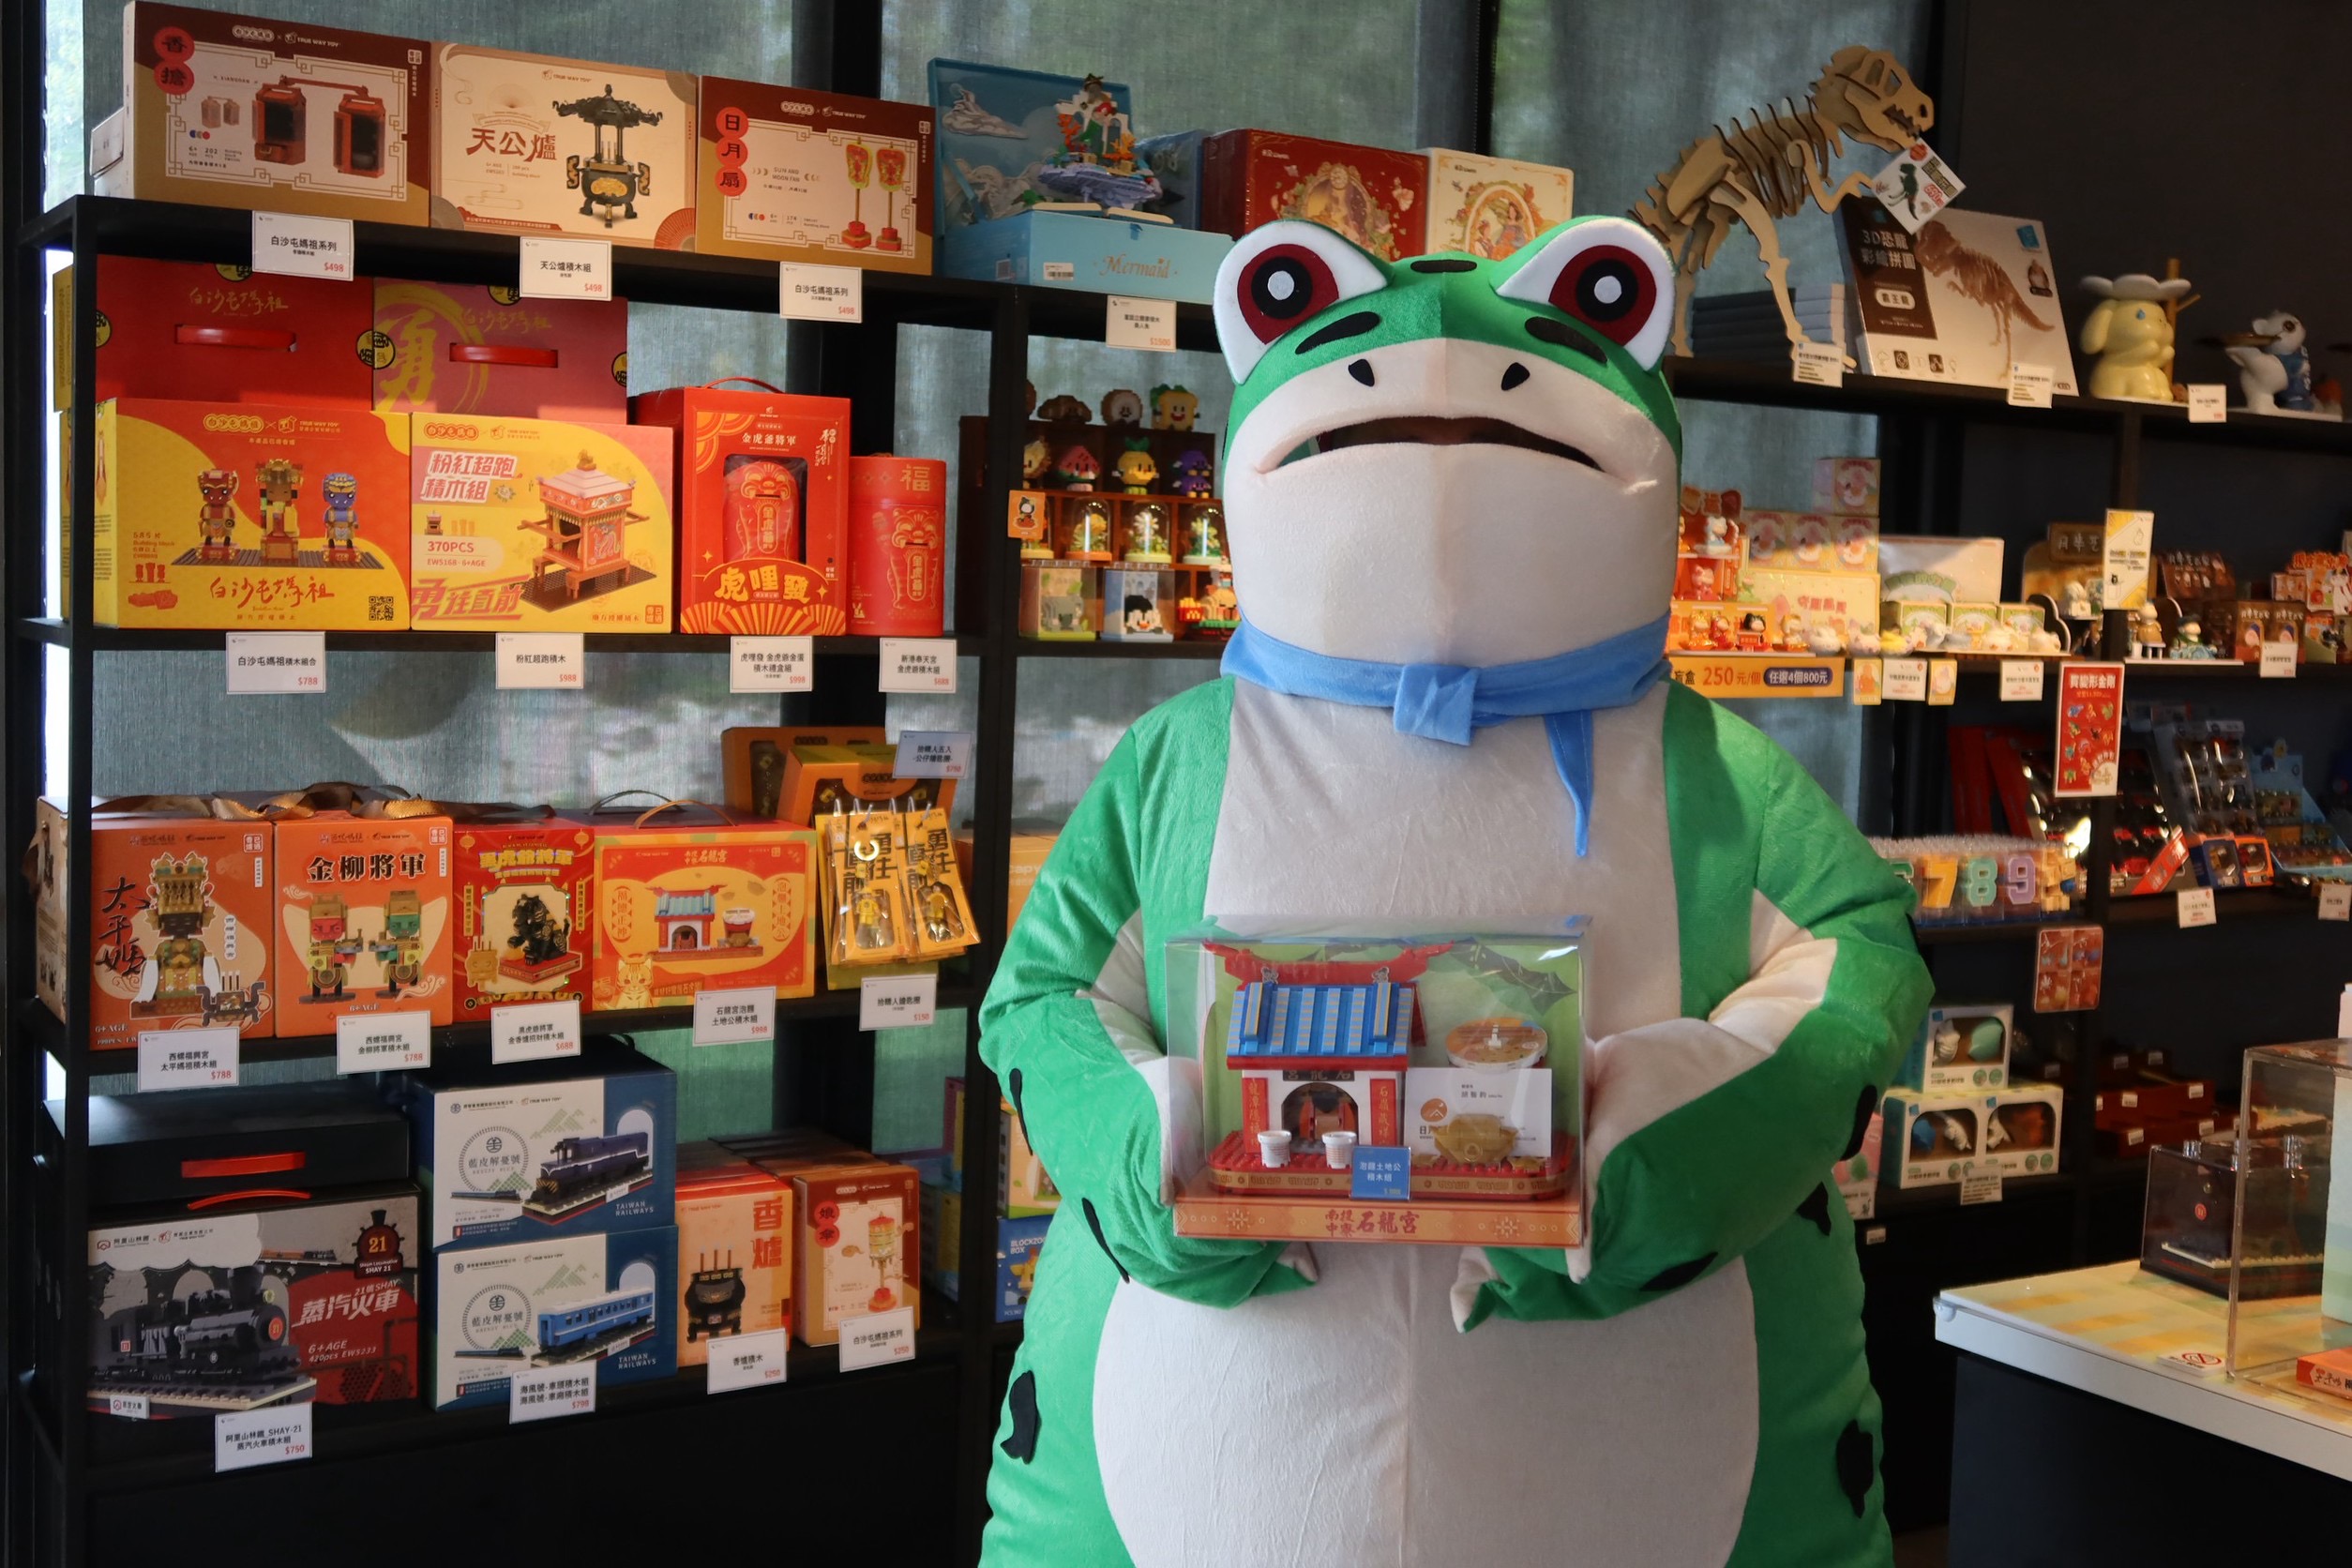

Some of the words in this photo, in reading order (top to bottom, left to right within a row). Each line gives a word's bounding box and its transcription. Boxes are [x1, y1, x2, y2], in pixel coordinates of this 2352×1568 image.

[466, 128, 556, 162] 天公爐
[720, 113, 741, 188] 日月扇
[271, 236, 337, 251] 白沙屯媽祖系列
[324, 263, 344, 272] $498
[540, 261, 592, 273] 天公爐積木組
[1099, 253, 1171, 279] Mermaid
[584, 283, 602, 293] $498
[795, 284, 849, 297] 白沙屯媽祖系列
[430, 453, 515, 478] 粉紅超跑
[899, 463, 930, 491] 福
[428, 541, 475, 553] 370PCS
[238, 656, 317, 667] 白沙屯媽祖積木組合
[516, 655, 566, 664] 粉紅超跑積木
[297, 676, 318, 686] $788
[559, 674, 577, 683] $988
[1702, 666, 1734, 686] 250
[307, 852, 427, 882] 金柳將軍
[712, 1015, 758, 1027] 土地公積木組
[555, 1042, 573, 1051] $688
[169, 1051, 209, 1062] 西螺福興宮
[404, 1053, 423, 1063] $788
[160, 1060, 218, 1072] 太平媽祖積木組
[211, 1070, 232, 1079] $788
[1367, 1173, 1393, 1183] 積木組
[615, 1206, 654, 1217] RAILWAYS
[616, 1201, 645, 1211] TAIWAN
[1357, 1210, 1420, 1234] 石龍宮
[750, 1195, 783, 1270] 香爐
[369, 1236, 387, 1254] 21
[366, 1266, 382, 1274] SHAY
[384, 1264, 391, 1273] 21
[291, 1289, 401, 1328] 蒸汽火車
[853, 1329, 903, 1345] 白沙屯媽祖系列
[894, 1346, 910, 1356] $250
[619, 1353, 648, 1363] TAIWAN
[733, 1354, 763, 1365] 香爐積木
[618, 1359, 656, 1370] RAILWAYS
[765, 1369, 780, 1379] $250
[237, 1436, 292, 1452] 蒸汽火車積木組
[285, 1444, 305, 1455] $750
